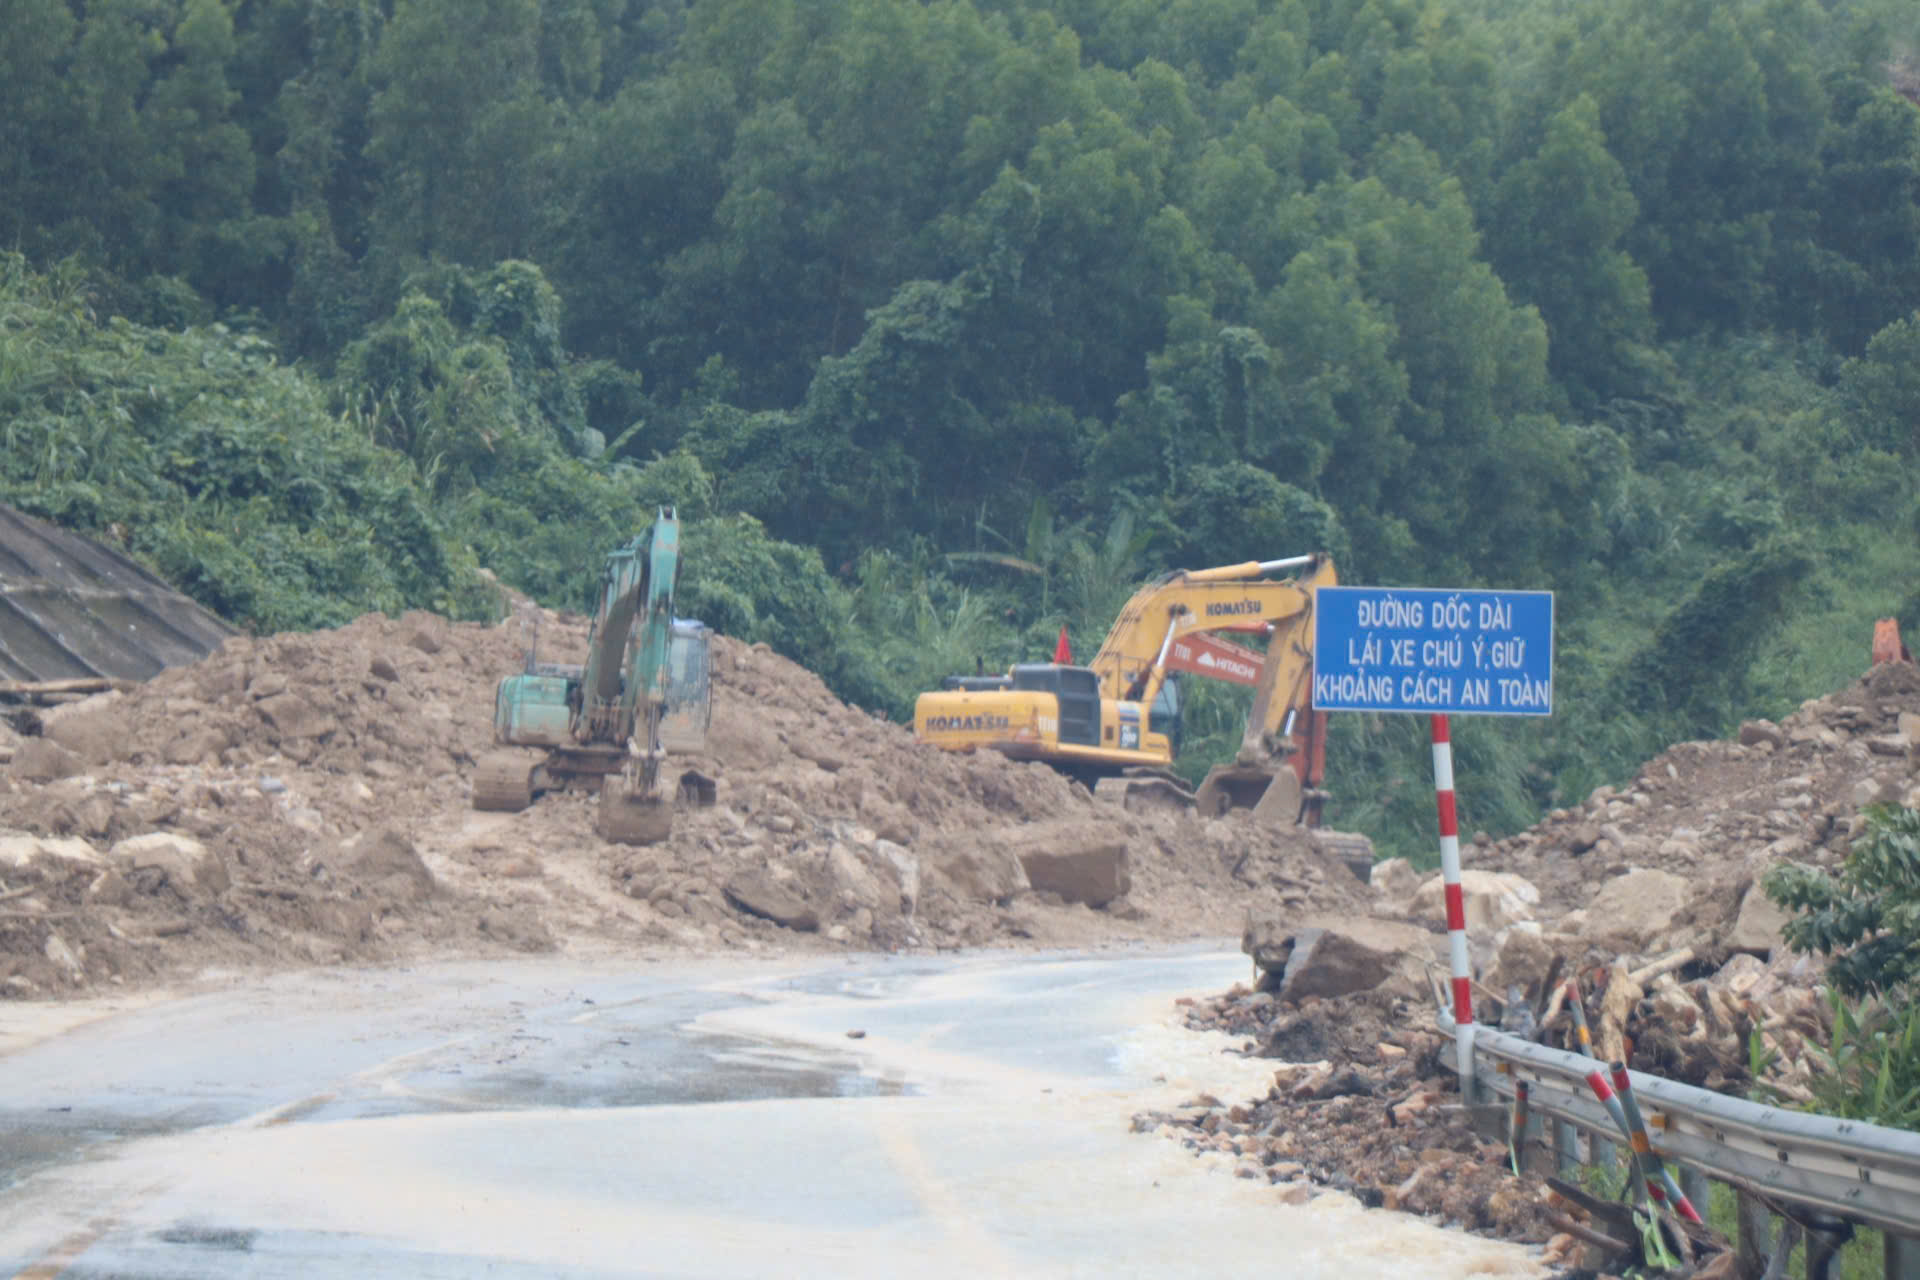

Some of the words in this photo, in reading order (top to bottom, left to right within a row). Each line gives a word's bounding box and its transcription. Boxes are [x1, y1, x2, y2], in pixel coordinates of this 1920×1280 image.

[1206, 598, 1262, 616] KOMATSU
[1358, 593, 1423, 628] ĐƯỜNG
[1432, 593, 1471, 629] DỐC
[1480, 597, 1512, 630] DÀI
[1349, 632, 1381, 666] LÁI
[1390, 639, 1415, 666] XE
[1423, 634, 1461, 667] CHÚ
[1492, 636, 1527, 669] GIỮ
[1214, 656, 1256, 680] HITACHI
[1316, 668, 1393, 703] KHOẢNG
[1401, 671, 1451, 705] CÁCH
[1461, 678, 1490, 706] AN
[1498, 673, 1549, 707] TOÀN
[925, 712, 1009, 733] KOMATSU
